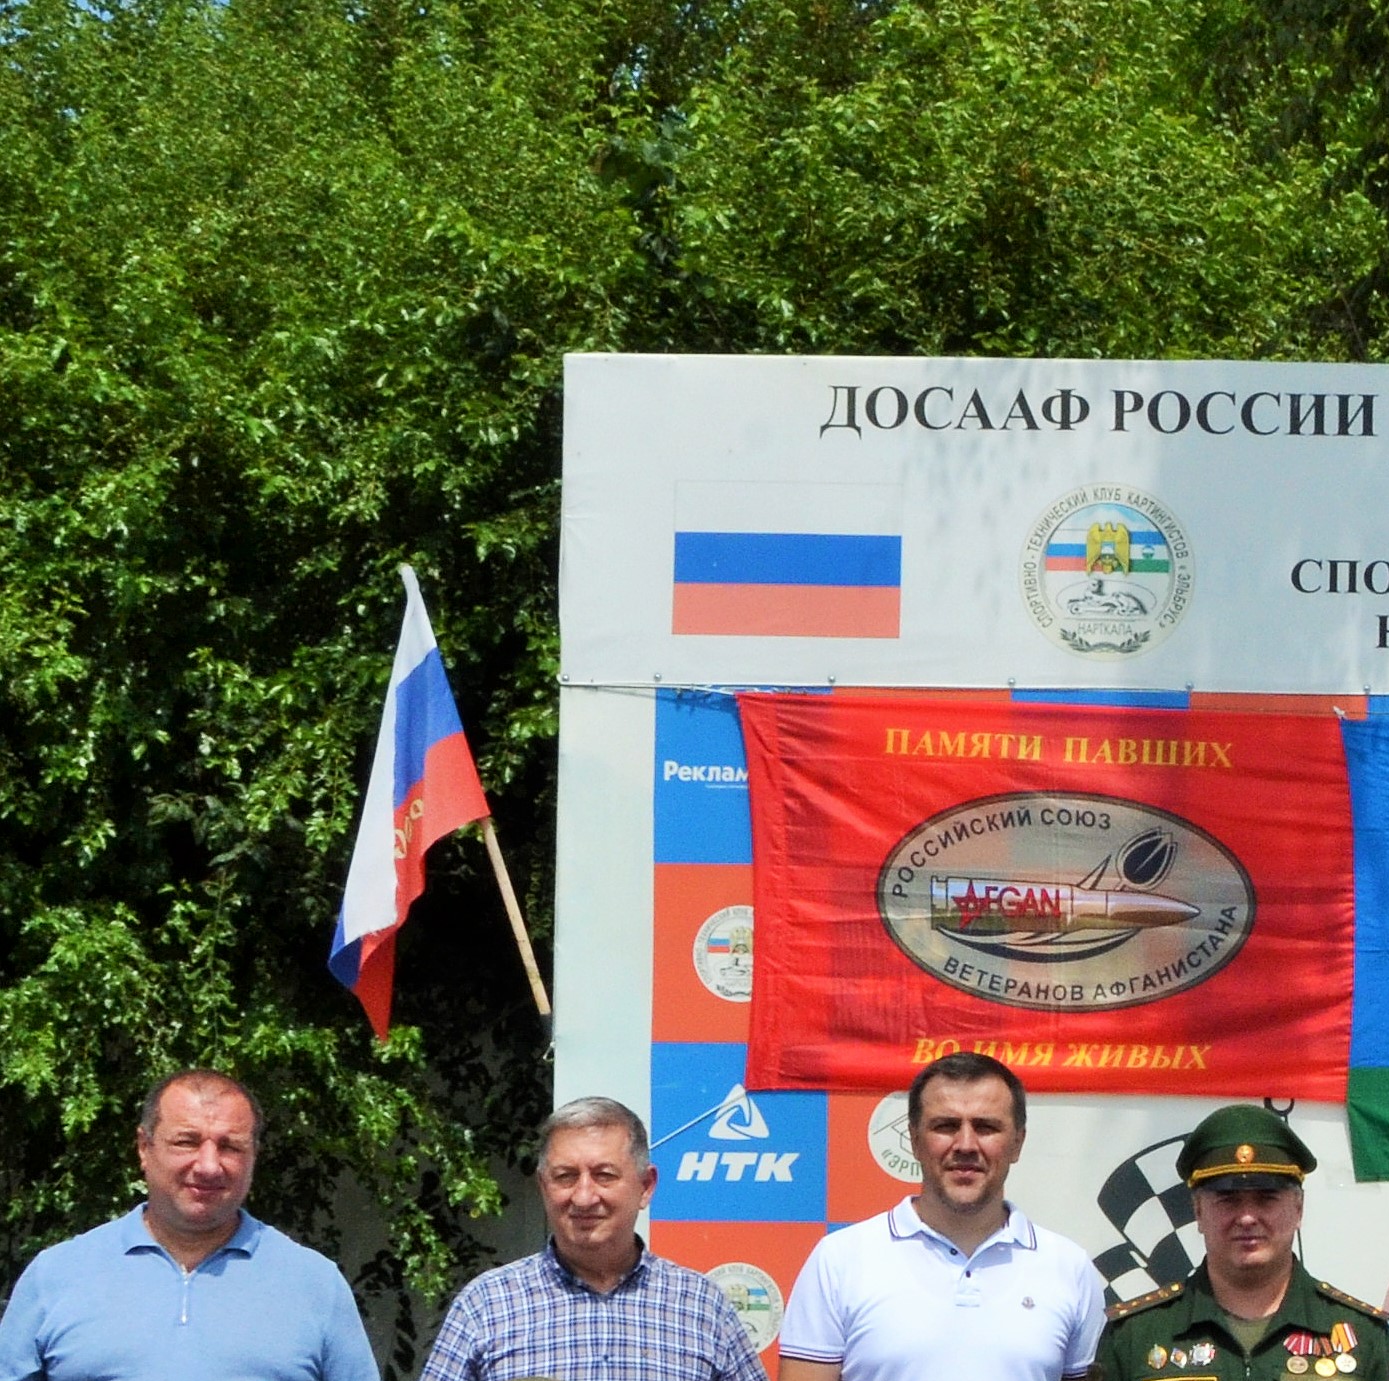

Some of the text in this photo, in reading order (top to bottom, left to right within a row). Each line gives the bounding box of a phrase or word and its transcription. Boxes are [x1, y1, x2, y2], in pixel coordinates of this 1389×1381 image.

[819, 385, 1090, 440] ДОСААФ
[1111, 389, 1380, 436] РОССИИ
[1027, 490, 1087, 551] ТЕХНИЧЕСКИЙ
[1093, 488, 1121, 501] КЛУБ
[1127, 491, 1189, 558] КАРТИНГИСТОВ
[1024, 562, 1053, 628] СПОРТИВНО
[1078, 622, 1133, 636] НАРТКАЛА
[884, 728, 1233, 768] ПАМЯТИ ПАВШИХ
[892, 806, 1111, 898] РОССИЙСКИЙ СОЮЗ
[943, 904, 1237, 1001] ВЕТЕРАНОВ АФГАНИСТАНА
[1062, 1042, 1212, 1070] ЖИВЫХ
[676, 1151, 800, 1182] НТК
